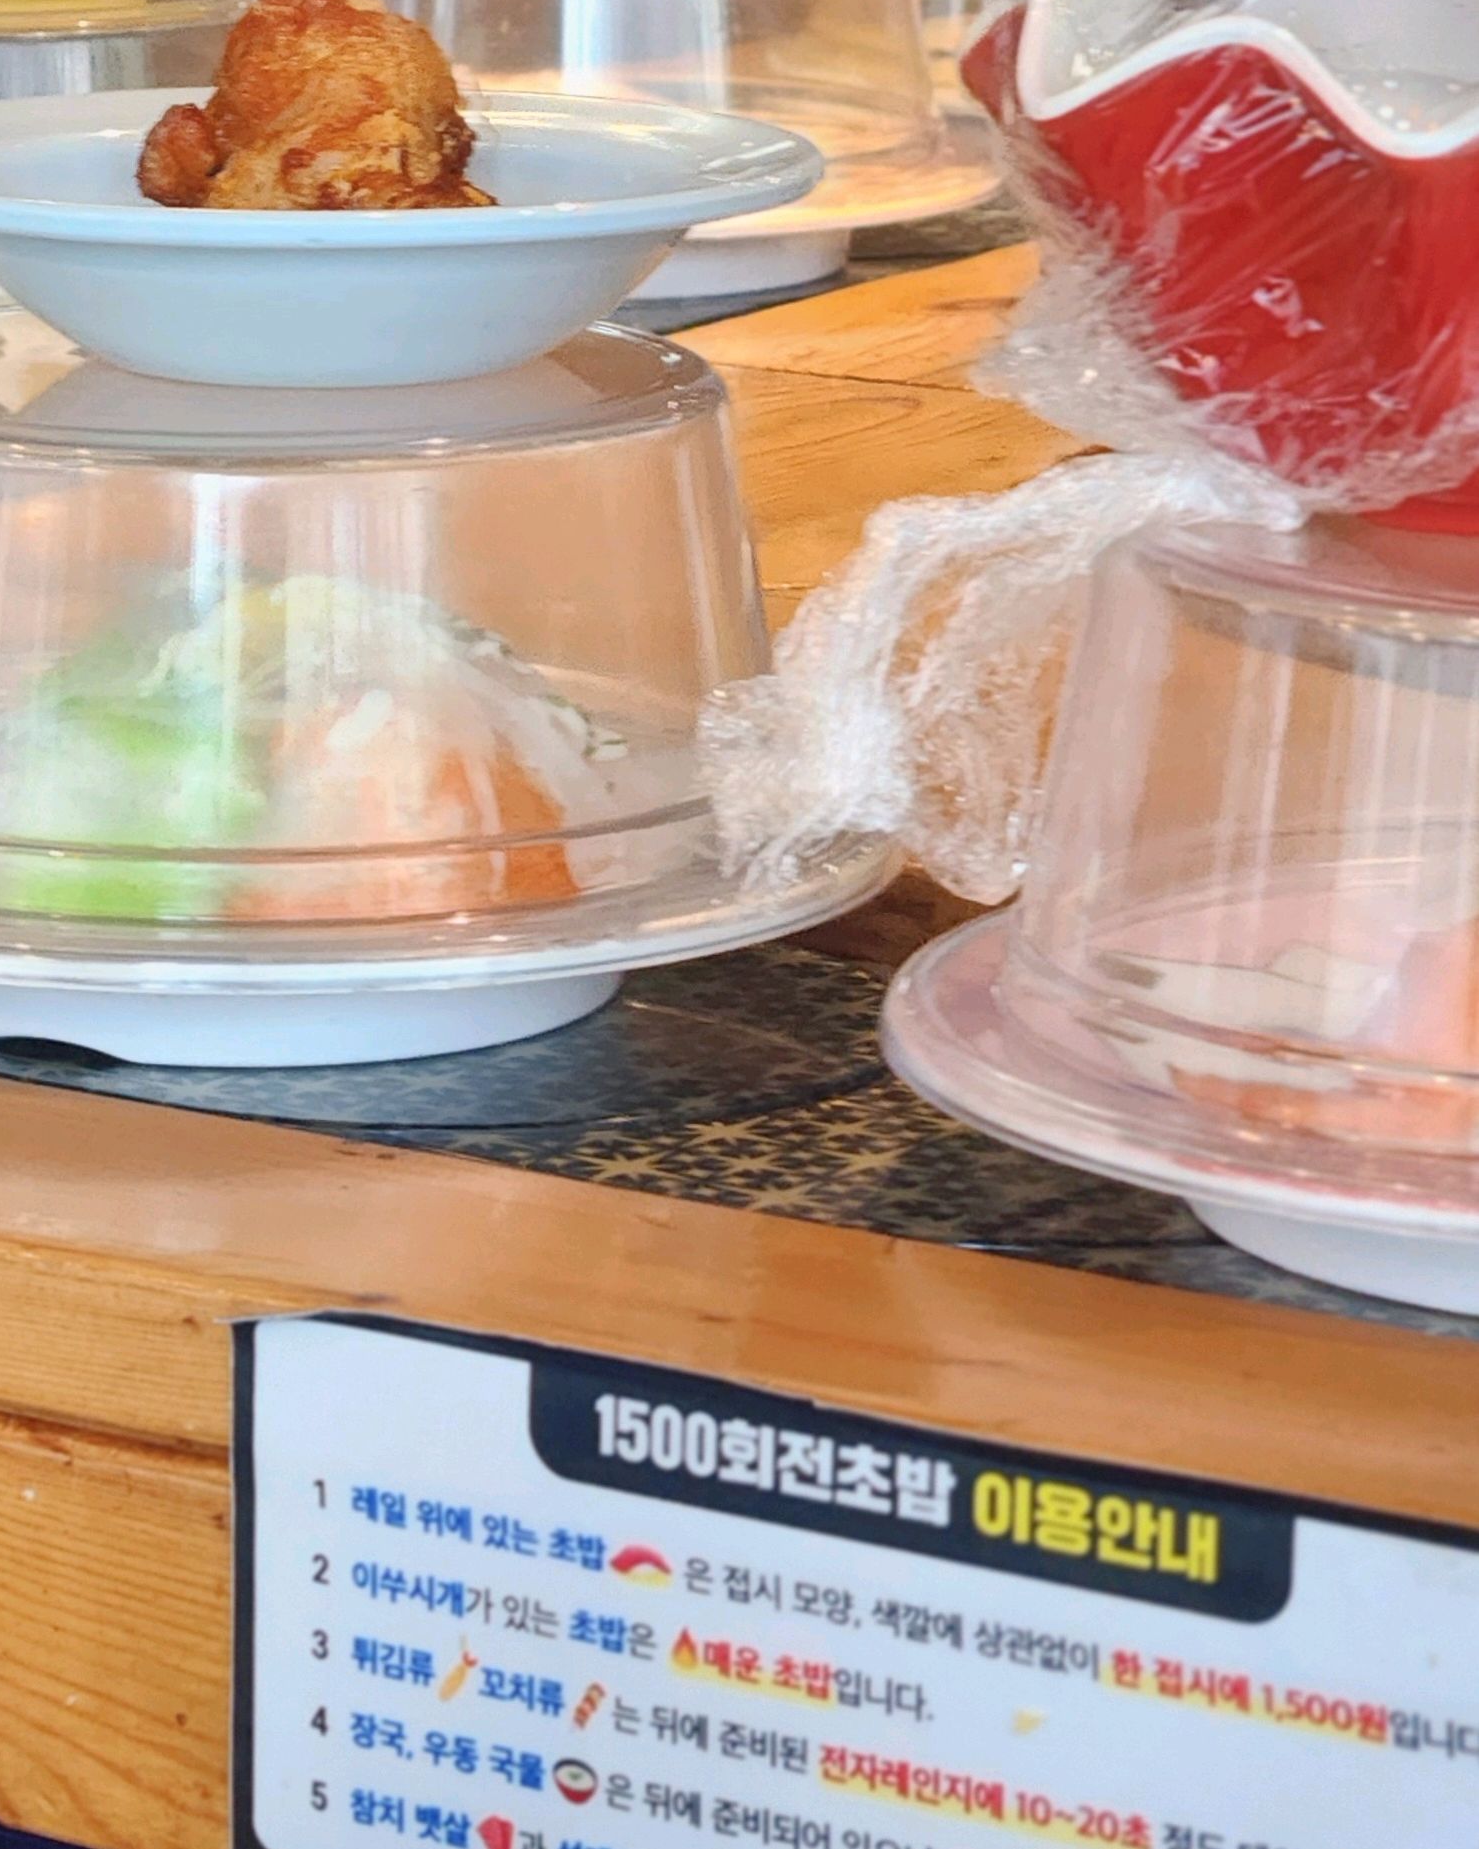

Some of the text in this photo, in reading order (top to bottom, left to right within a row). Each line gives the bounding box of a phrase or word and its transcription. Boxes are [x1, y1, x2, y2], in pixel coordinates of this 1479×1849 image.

[595, 1393, 1219, 1584] 1500회전초밥 이용안내
[312, 1553, 934, 1723] 2 이쑤시개가 있는 초밥은 매운 초밥입니다.
[313, 1479, 326, 1508] 1
[351, 1486, 407, 1529] 레일
[417, 1499, 472, 1543] 위에
[482, 1512, 538, 1557] 있는
[548, 1528, 606, 1572] 초밥
[684, 1556, 713, 1596] 은
[723, 1565, 782, 1611] 접시
[873, 1599, 963, 1649] 색깔에
[975, 1619, 1100, 1681] 상관없이
[1112, 1648, 1142, 1689] 한
[1154, 1657, 1251, 1714] 접시에
[311, 1706, 328, 1737] 4
[423, 1730, 479, 1774] 우동
[489, 1744, 545, 1792] 국물
[605, 1772, 635, 1813] 은
[643, 1782, 702, 1829] 뒤에
[712, 1797, 832, 1849] 준비되어
[311, 1781, 328, 1812] 5
[350, 1788, 406, 1835] 참치
[312, 1629, 329, 1660] 3
[351, 1636, 436, 1688] 튀김류
[478, 1666, 566, 1718] 꼬치류
[611, 1698, 642, 1736] 는
[650, 1706, 709, 1751] 뒤에
[718, 1720, 809, 1775] 준비된
[819, 1743, 1004, 1822] 전자레인지에
[1015, 1791, 1152, 1849] 10~20초
